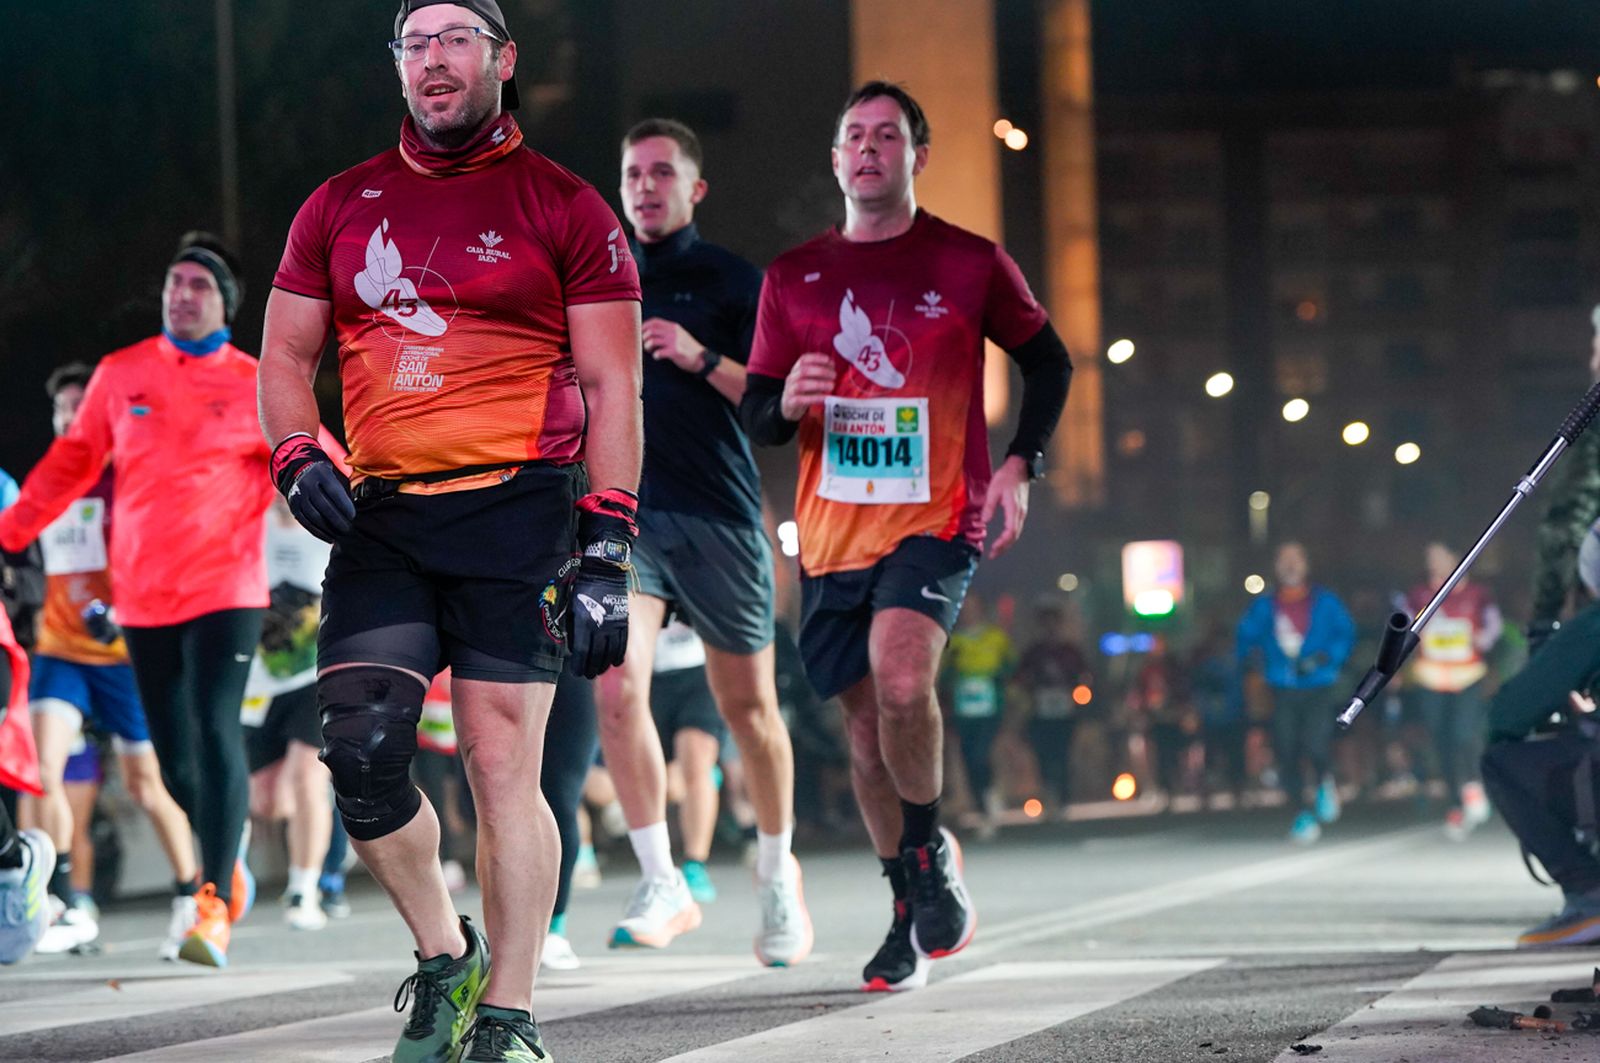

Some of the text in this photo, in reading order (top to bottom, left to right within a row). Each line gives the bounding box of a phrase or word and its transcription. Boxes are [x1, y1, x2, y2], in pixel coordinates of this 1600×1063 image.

[381, 288, 418, 318] 43
[397, 360, 427, 373] SAN
[857, 345, 881, 372] 43
[393, 371, 445, 387] ANTÓN
[836, 437, 912, 467] 14014
